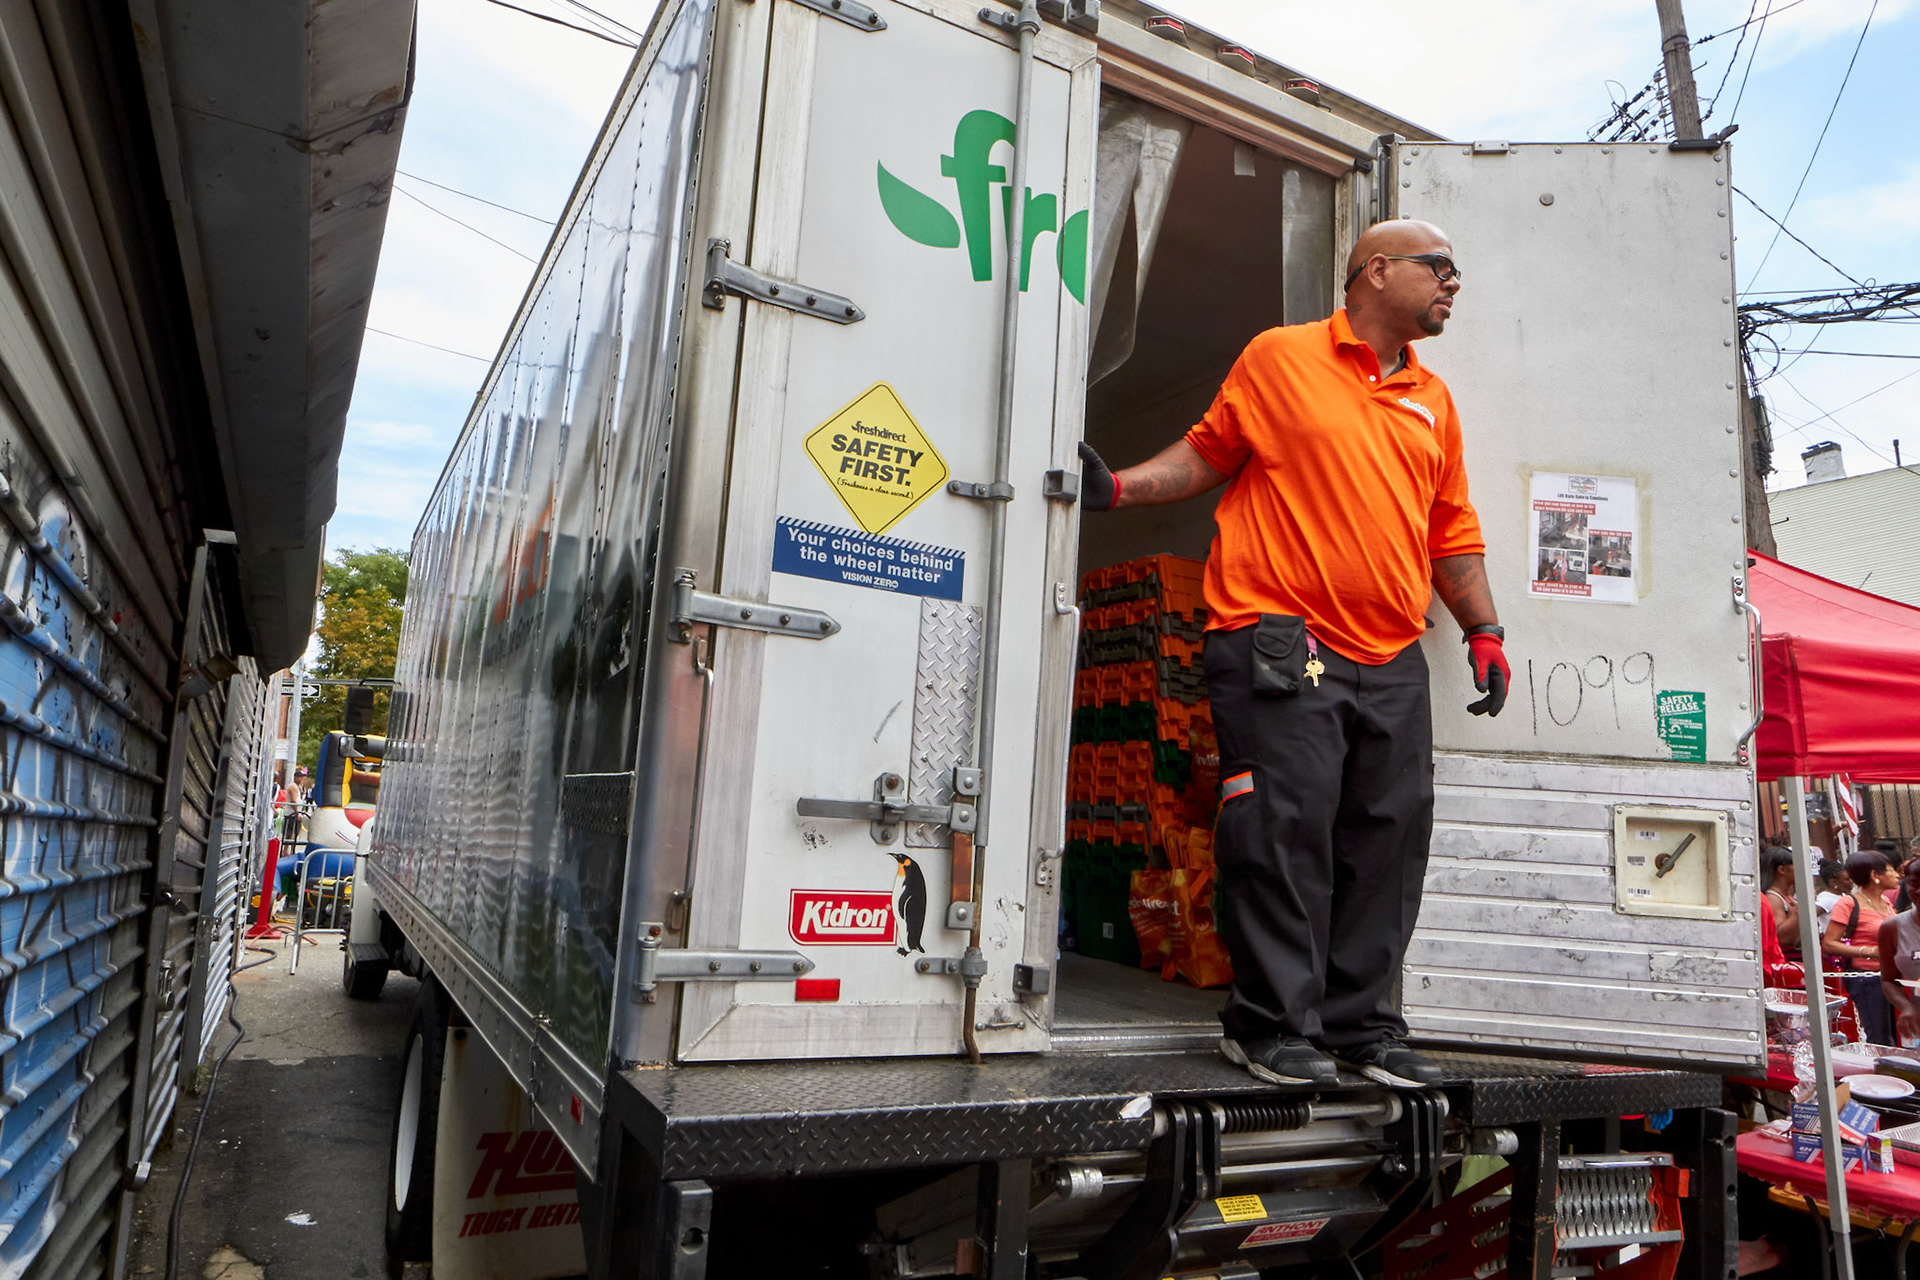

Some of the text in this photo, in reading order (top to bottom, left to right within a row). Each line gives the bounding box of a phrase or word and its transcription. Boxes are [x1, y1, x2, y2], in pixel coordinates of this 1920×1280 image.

[852, 420, 908, 443] freshdirect
[831, 433, 924, 467] SAFETY
[839, 456, 911, 487] FIRST.
[787, 527, 953, 571] Your choices behind
[799, 546, 941, 584] the wheel matter
[842, 571, 872, 584] VISION
[873, 576, 899, 589] ZERO
[1528, 651, 1658, 736] 1099
[1660, 694, 1693, 706] SAFETY
[1660, 701, 1699, 714] RELEASE
[1659, 728, 1667, 738] 2
[1661, 716, 1666, 727] 1
[800, 901, 888, 934] Kidron
[459, 1207, 528, 1239] TRUCK
[1253, 1220, 1327, 1235] ANTHONY
